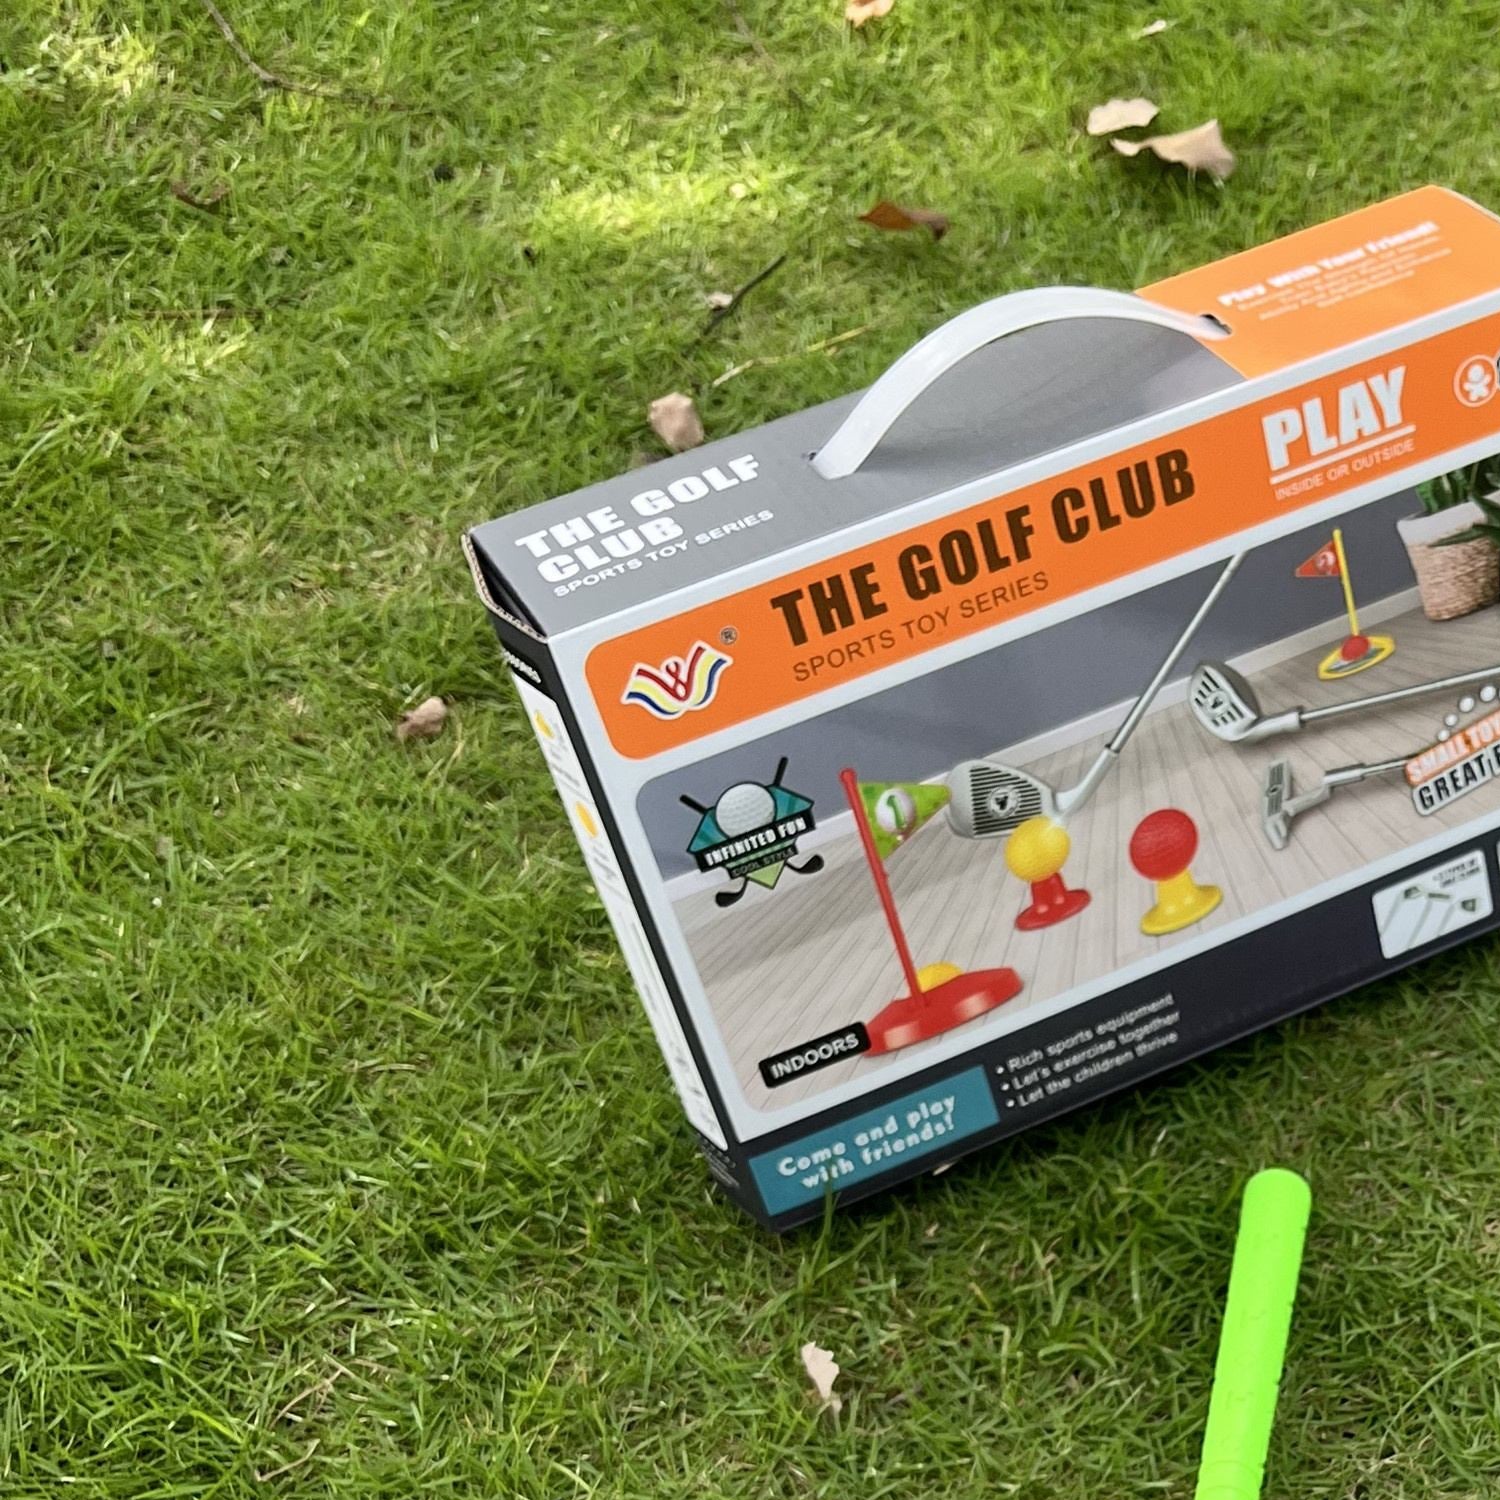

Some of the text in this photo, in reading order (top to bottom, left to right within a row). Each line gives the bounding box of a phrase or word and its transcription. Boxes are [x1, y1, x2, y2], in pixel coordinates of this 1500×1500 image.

[1261, 365, 1407, 471] PLAY
[515, 454, 759, 558] THE GOLF
[1274, 439, 1415, 501] INSIDE OR OUTSIDE
[537, 517, 684, 582] CLUB
[554, 509, 774, 597] SPORTS TOY SERIES
[771, 448, 1196, 647] THE GOLF CLUB
[792, 571, 1049, 682] SPORTS TOY SERIES
[1409, 733, 1467, 780] SMALL
[1418, 753, 1486, 810] GREAT
[704, 817, 806, 866] INFINITED FUN
[770, 1033, 859, 1079] INDOORS
[1007, 993, 1175, 1072] Rich sports equipment
[1012, 1011, 1180, 1090] Let's exercise together
[1017, 1031, 1179, 1107] Let the children thrive
[778, 1141, 846, 1177] Come
[854, 1115, 898, 1147] and
[907, 1095, 956, 1129] play
[802, 1112, 956, 1189] with friends!
